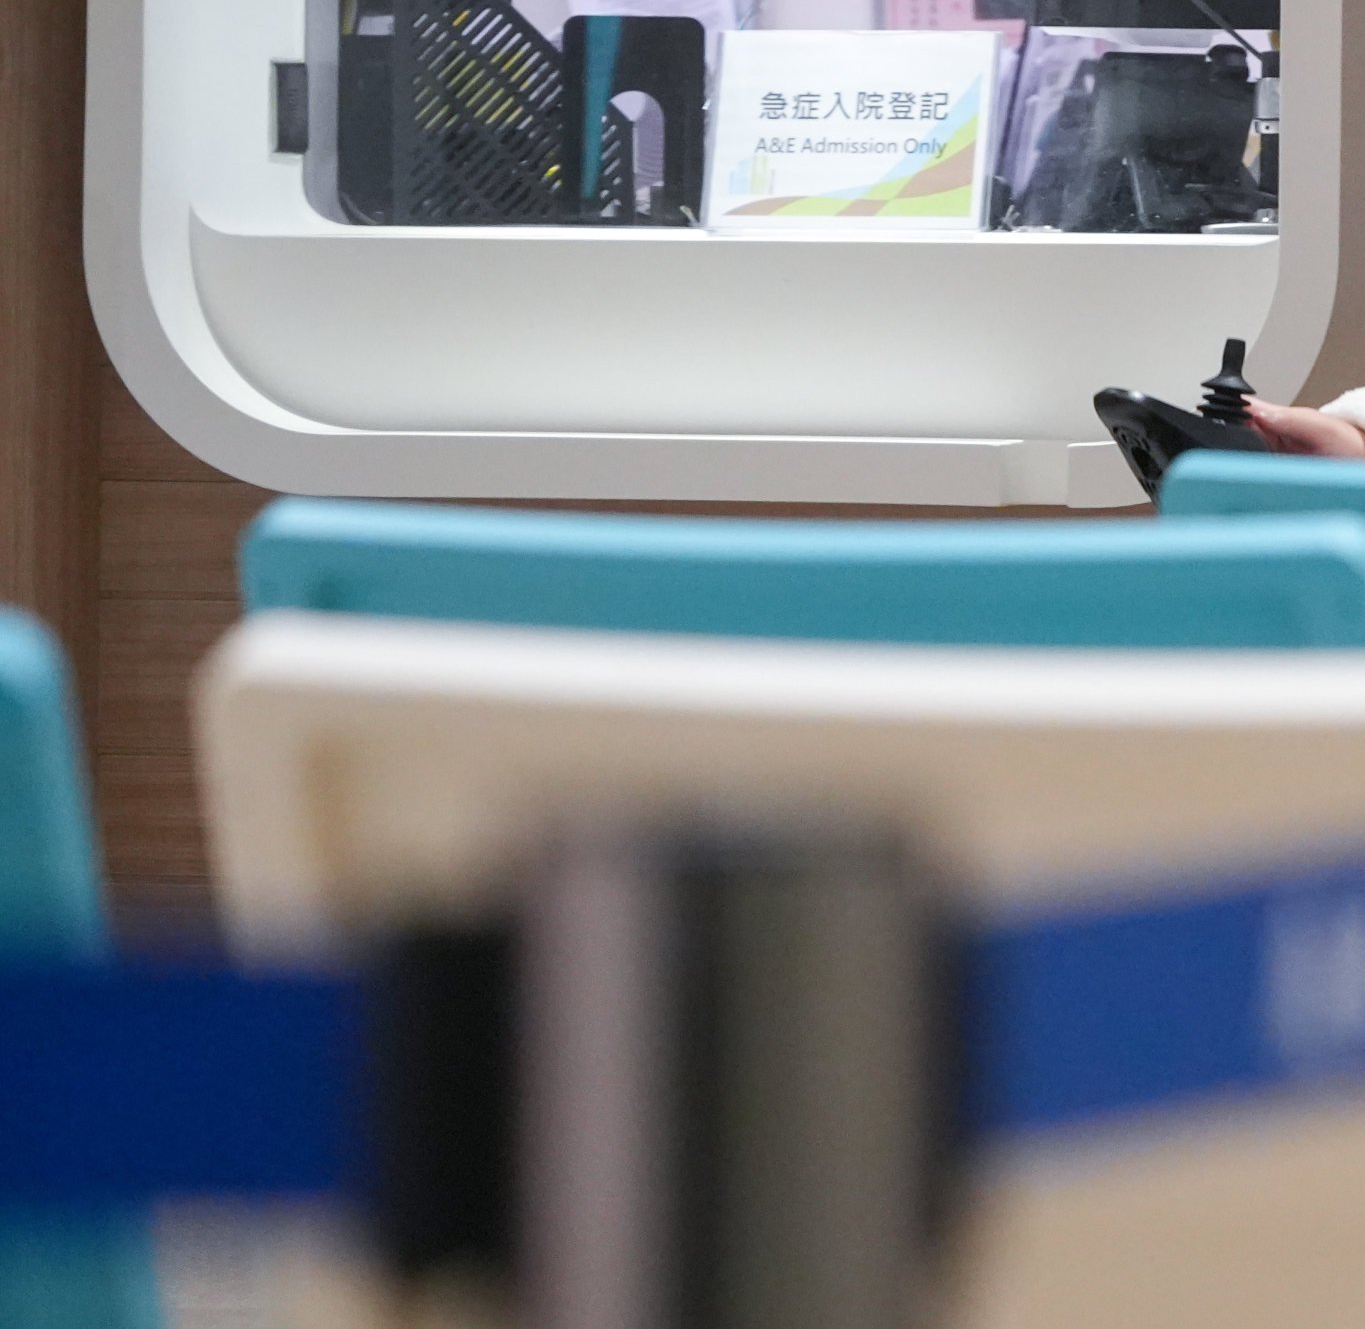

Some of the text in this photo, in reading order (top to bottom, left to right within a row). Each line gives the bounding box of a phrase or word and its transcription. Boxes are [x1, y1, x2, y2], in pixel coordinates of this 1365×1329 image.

[759, 91, 949, 121] 急症入院登記
[755, 138, 947, 158] A&E Admission Only
